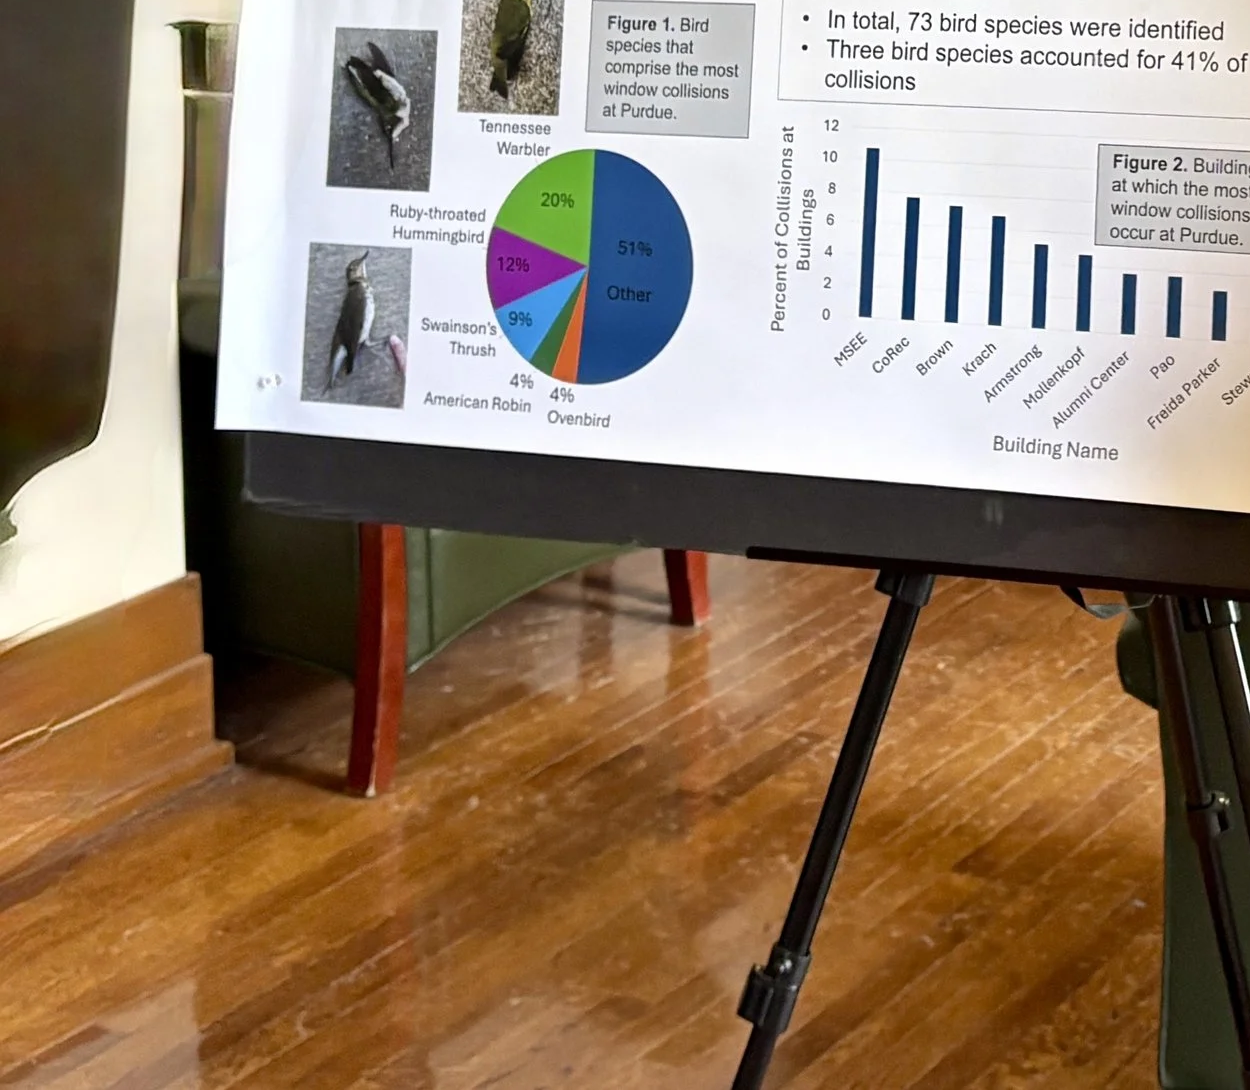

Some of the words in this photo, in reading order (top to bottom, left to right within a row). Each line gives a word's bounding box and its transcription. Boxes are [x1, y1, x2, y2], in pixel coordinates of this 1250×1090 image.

[607, 15, 657, 34] Figure
[662, 16, 675, 32] 1.
[680, 17, 709, 33] Bird
[479, 119, 552, 135] Tennessee
[781, 126, 794, 143] at
[824, 119, 839, 132] 12
[496, 141, 551, 157] Warbler
[822, 150, 838, 163] 10
[1113, 153, 1168, 174] Figure
[1172, 156, 1188, 172] 2.
[774, 148, 793, 237] Collisions
[828, 181, 836, 195] 8
[540, 192, 575, 209] 20%
[390, 203, 486, 222] Ruby-throated
[826, 213, 835, 226] 6
[392, 225, 485, 245] Hummingbird
[796, 189, 817, 271] Buildings
[617, 240, 653, 257] 51%
[774, 241, 788, 259] of
[824, 245, 833, 258] 4
[497, 256, 530, 272] 12%
[823, 276, 832, 289] 2
[606, 285, 652, 302] Other
[770, 263, 787, 332] Percent
[508, 311, 532, 327] 9%
[822, 308, 831, 321] 0
[449, 341, 496, 357] Thrush
[833, 331, 868, 367] MSEE
[872, 337, 910, 374] CoRec
[915, 340, 954, 376] Brown
[961, 343, 997, 377] Krach
[1149, 356, 1175, 380] Pao
[509, 373, 534, 390] 4%
[984, 344, 1043, 404] Armstrong
[1022, 345, 1085, 410] Mollenkopf
[549, 387, 575, 403] 4%
[1052, 385, 1093, 430] Alumni
[1090, 351, 1129, 390] Center
[1147, 394, 1185, 430] Freida
[1181, 357, 1220, 396] Parker
[423, 391, 489, 409] American
[492, 396, 532, 413] Robin
[547, 409, 611, 428] Ovenbird
[993, 435, 1063, 460] Building
[1066, 441, 1119, 461] Name
